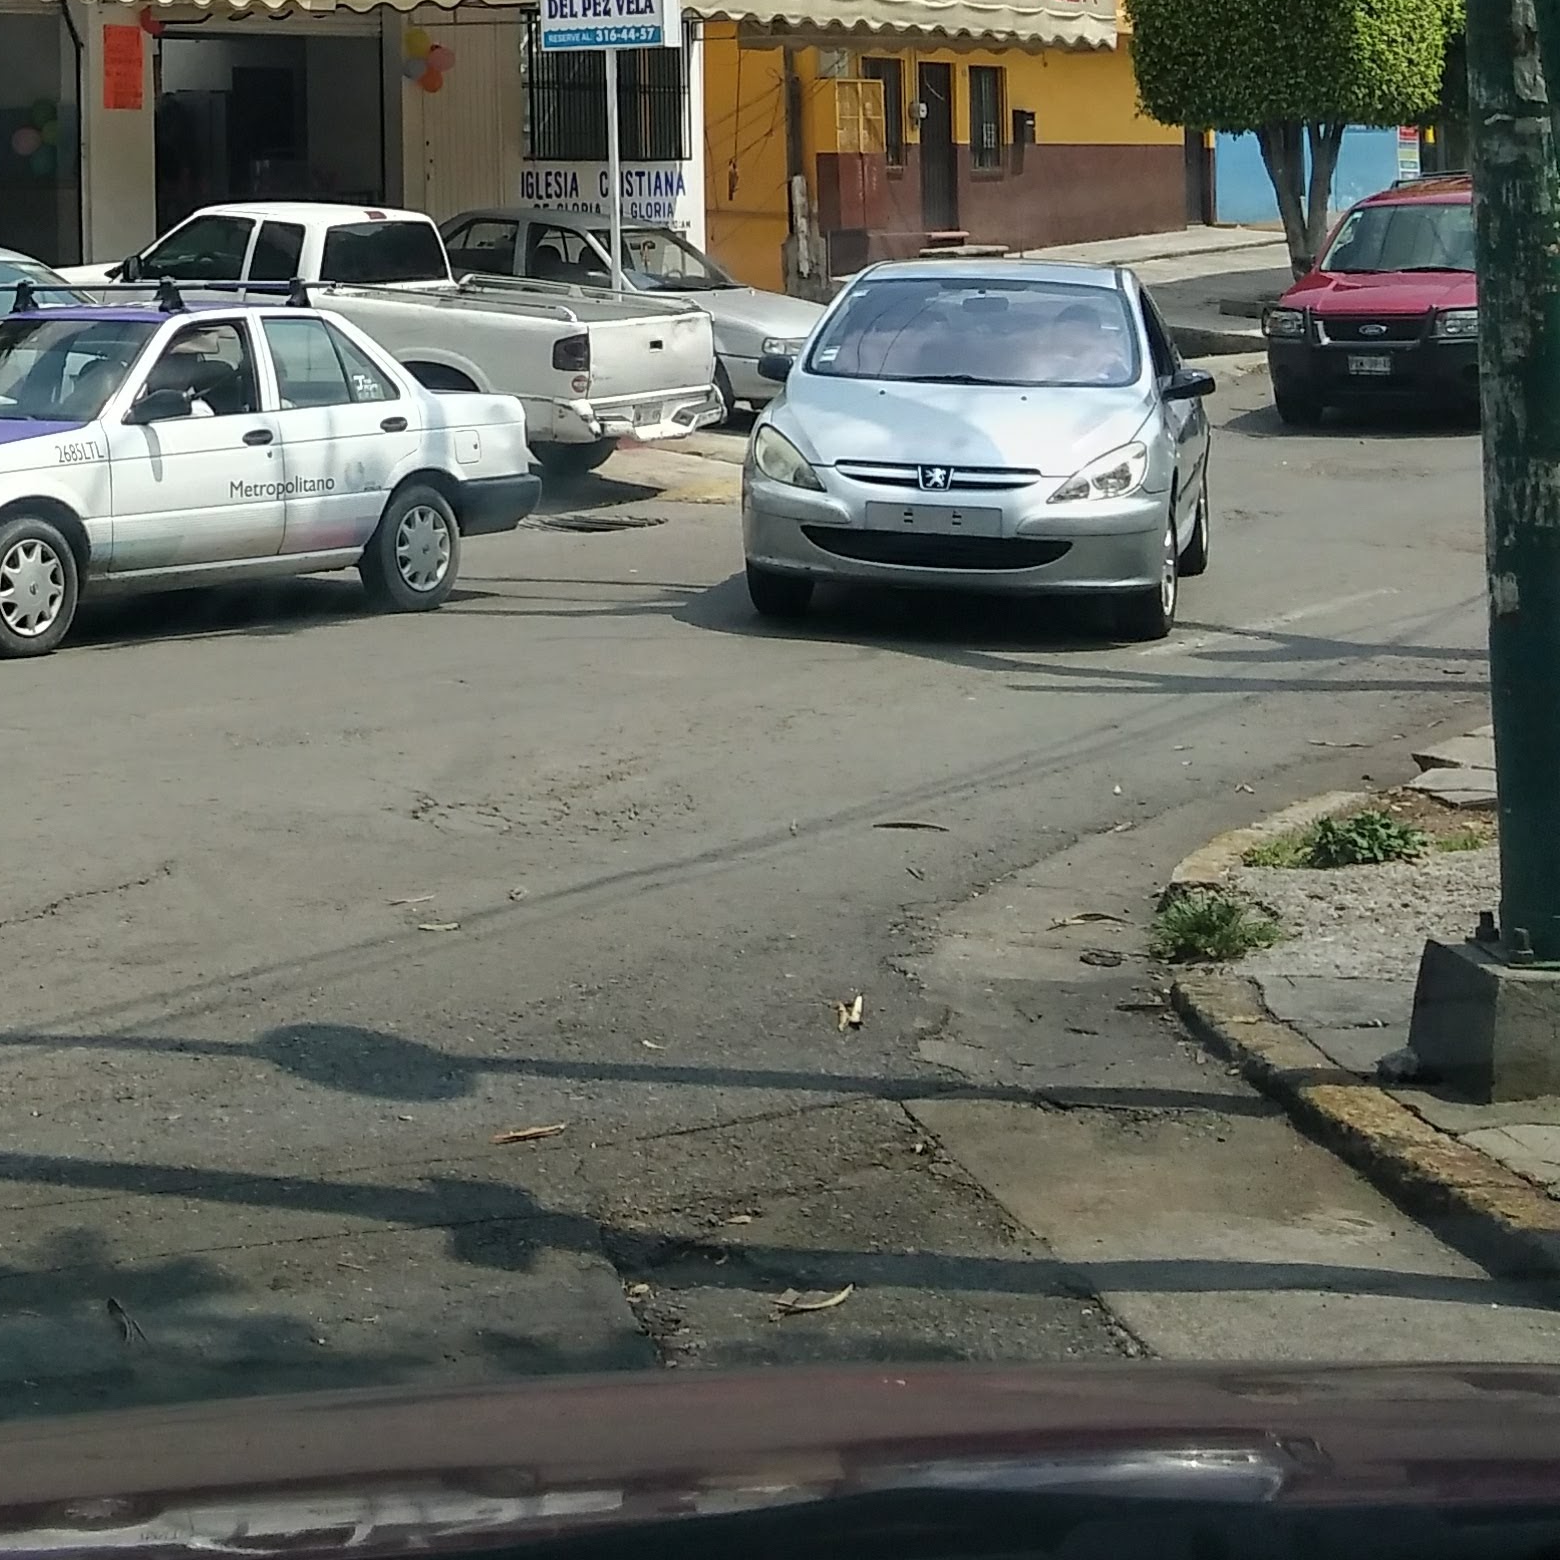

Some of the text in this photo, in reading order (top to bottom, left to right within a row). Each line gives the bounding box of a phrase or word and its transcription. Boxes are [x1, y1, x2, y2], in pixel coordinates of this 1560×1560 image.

[548, 32, 581, 43] RESERVE
[595, 28, 655, 43] 316-44-57
[521, 171, 687, 199] IGLESIA CISTIANA
[631, 201, 675, 219] GLORIA
[54, 441, 105, 464] 2685LTL
[229, 475, 336, 501] Metropolitano
